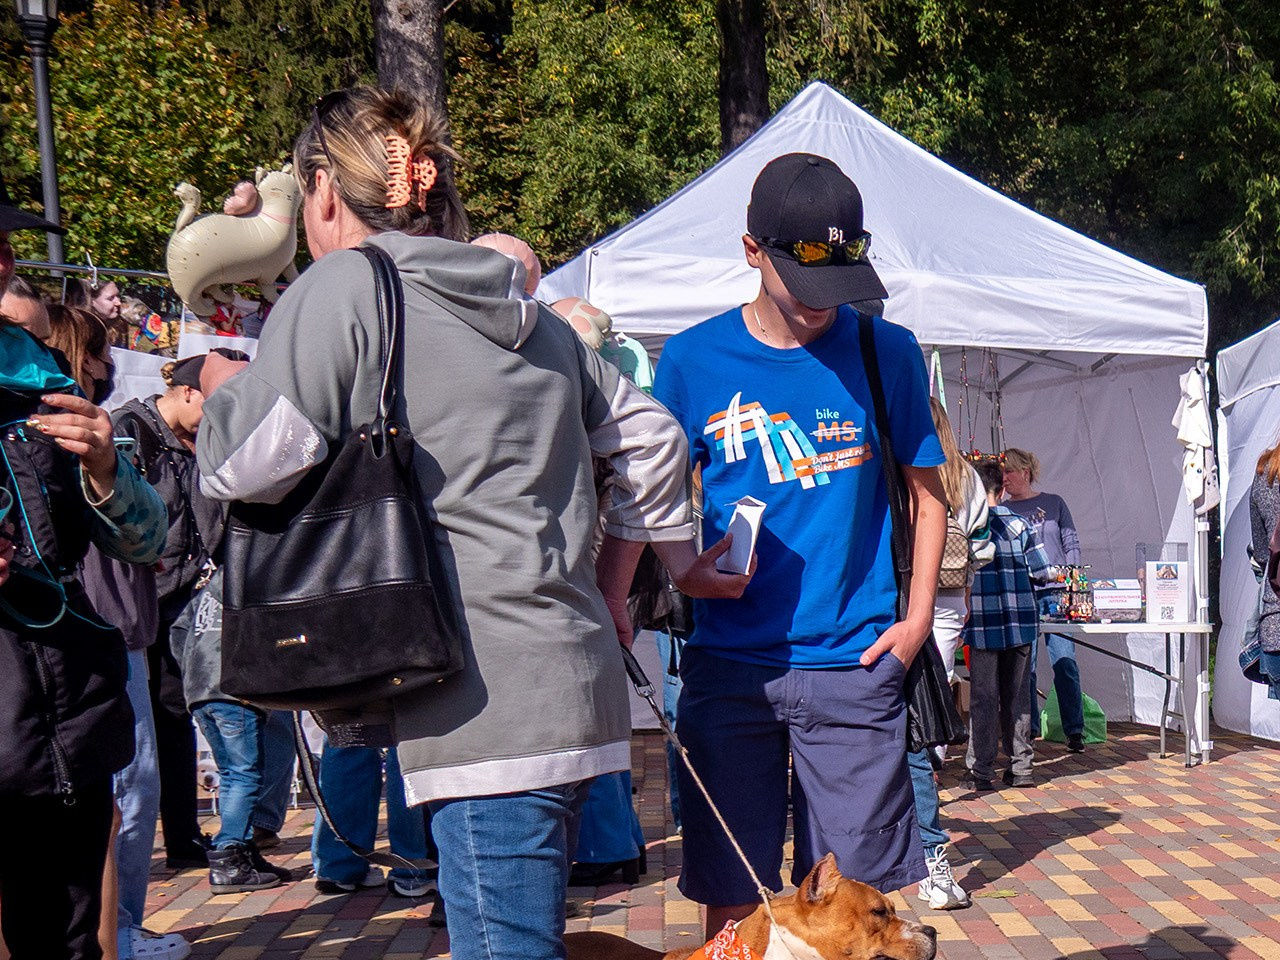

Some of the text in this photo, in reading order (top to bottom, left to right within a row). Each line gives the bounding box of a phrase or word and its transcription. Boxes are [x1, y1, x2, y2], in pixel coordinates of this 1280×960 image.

[815, 408, 840, 420] bike
[811, 452, 835, 465] Don't
[834, 448, 854, 462] just
[814, 459, 850, 474] Bike MS
